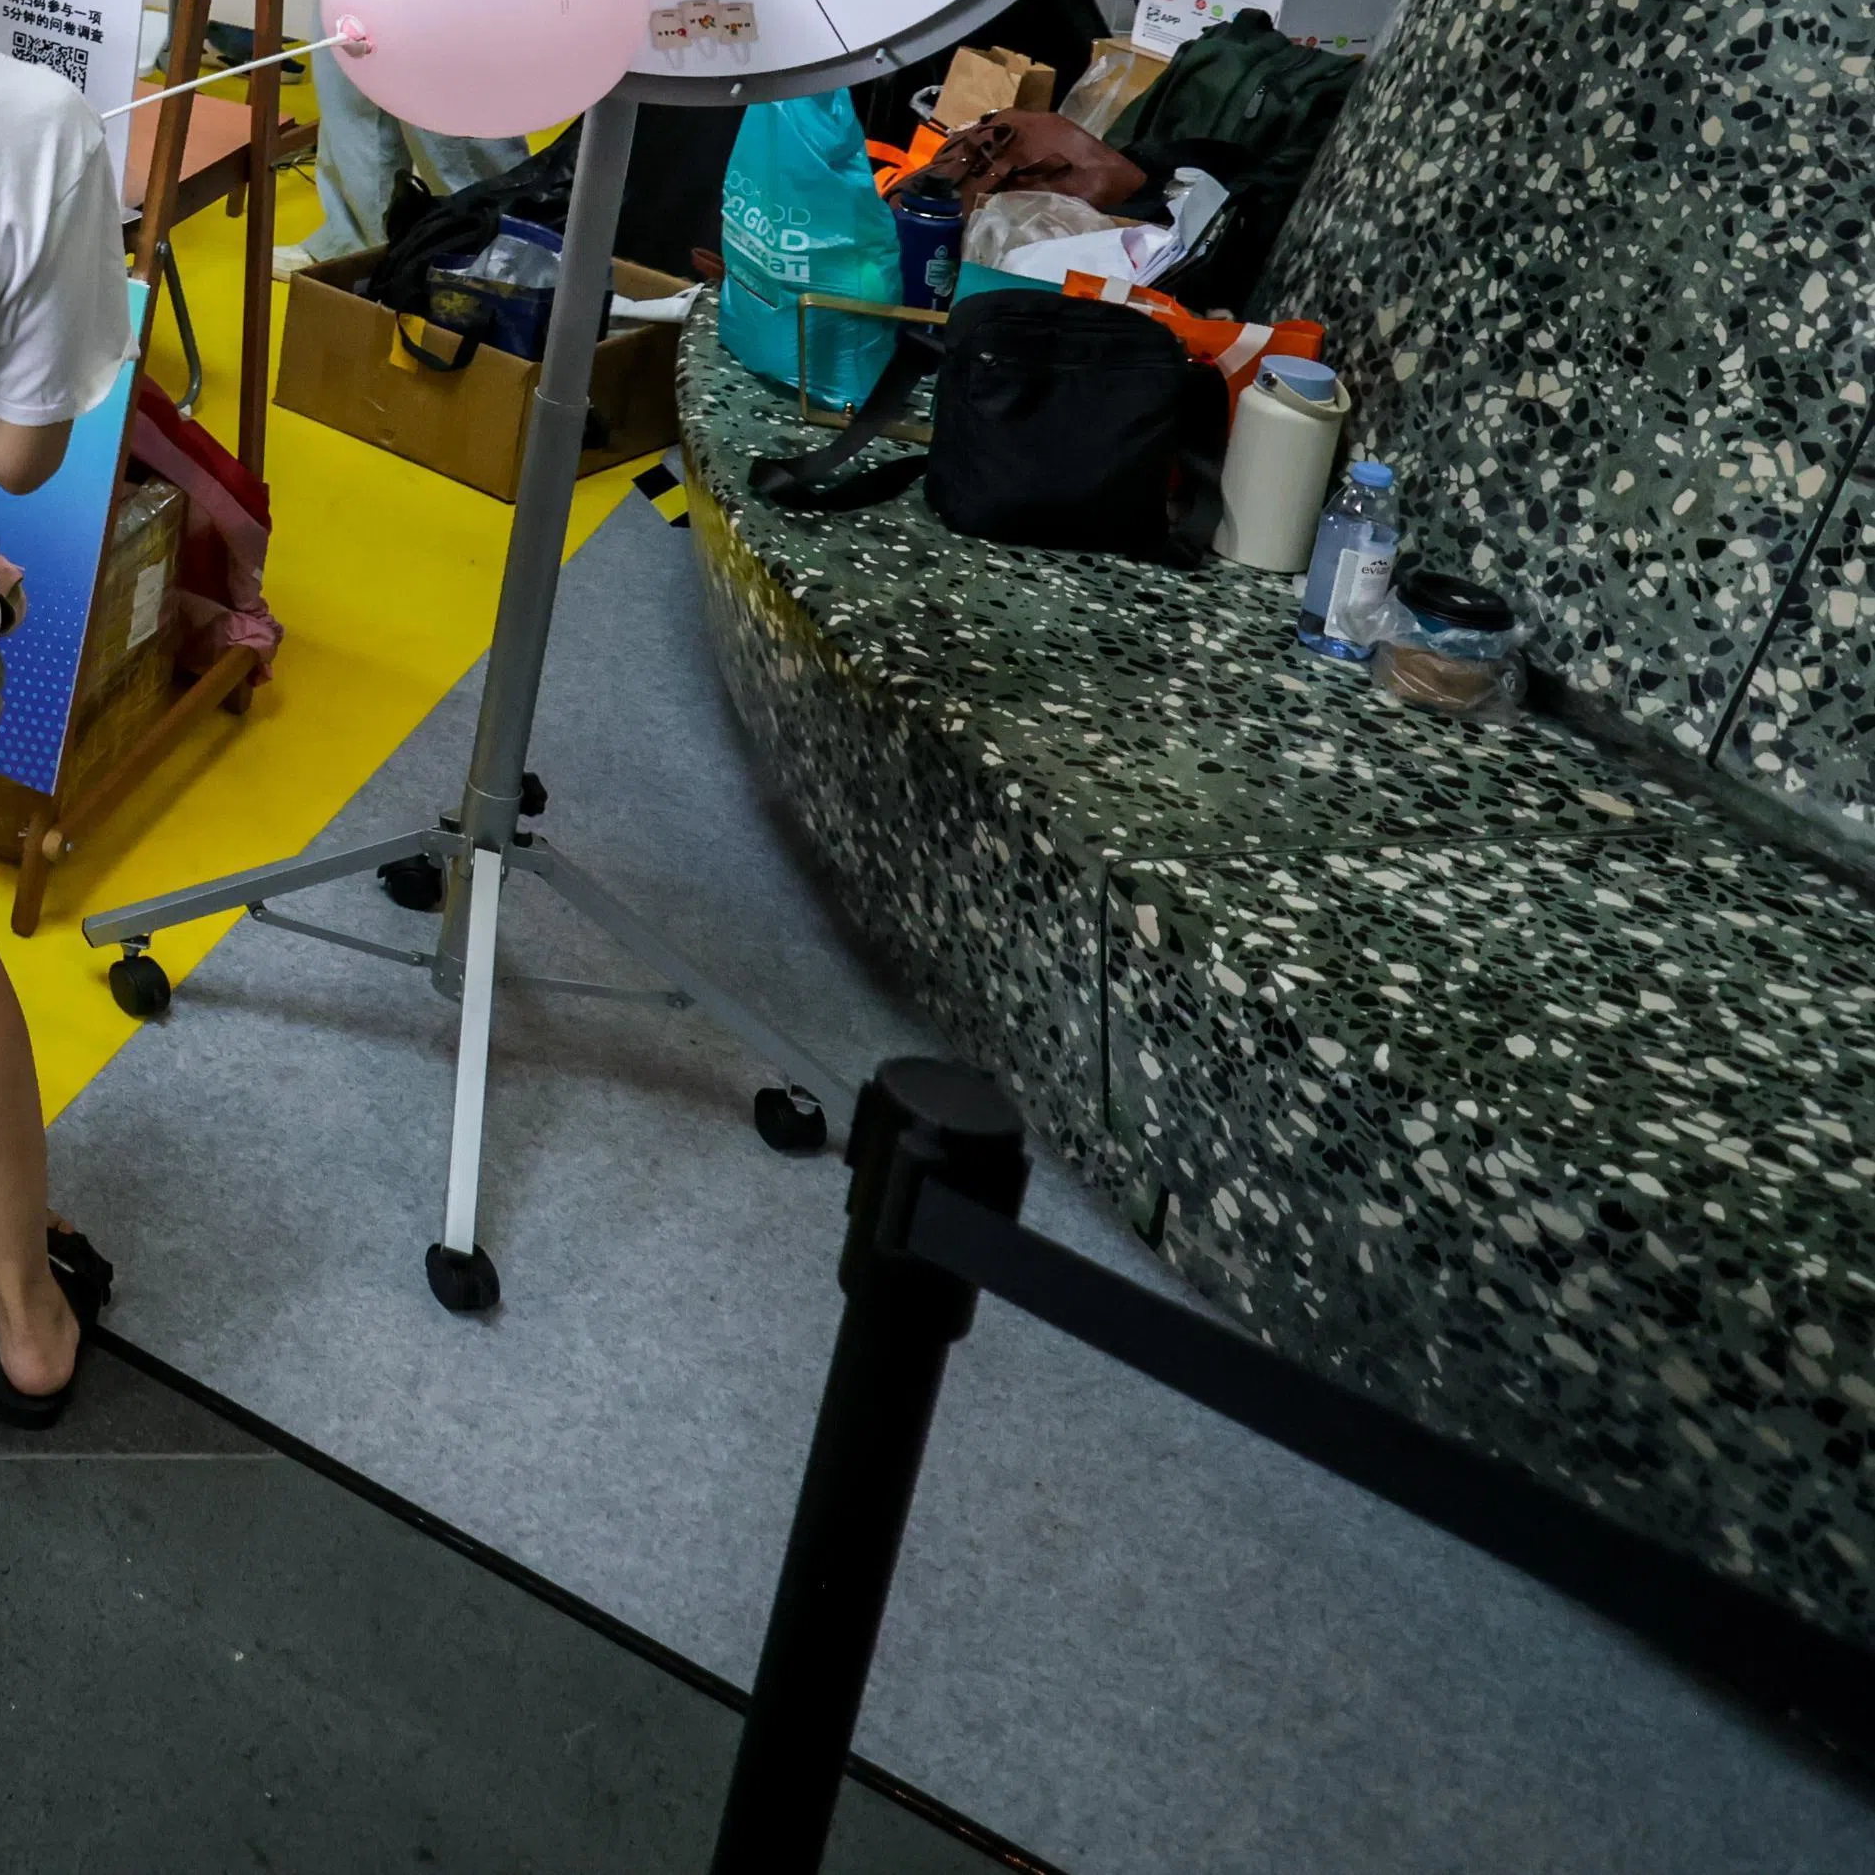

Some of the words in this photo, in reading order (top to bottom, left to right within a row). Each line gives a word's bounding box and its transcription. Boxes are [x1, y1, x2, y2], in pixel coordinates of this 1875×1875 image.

[2, 5, 104, 44] 5分钟的问卷调查
